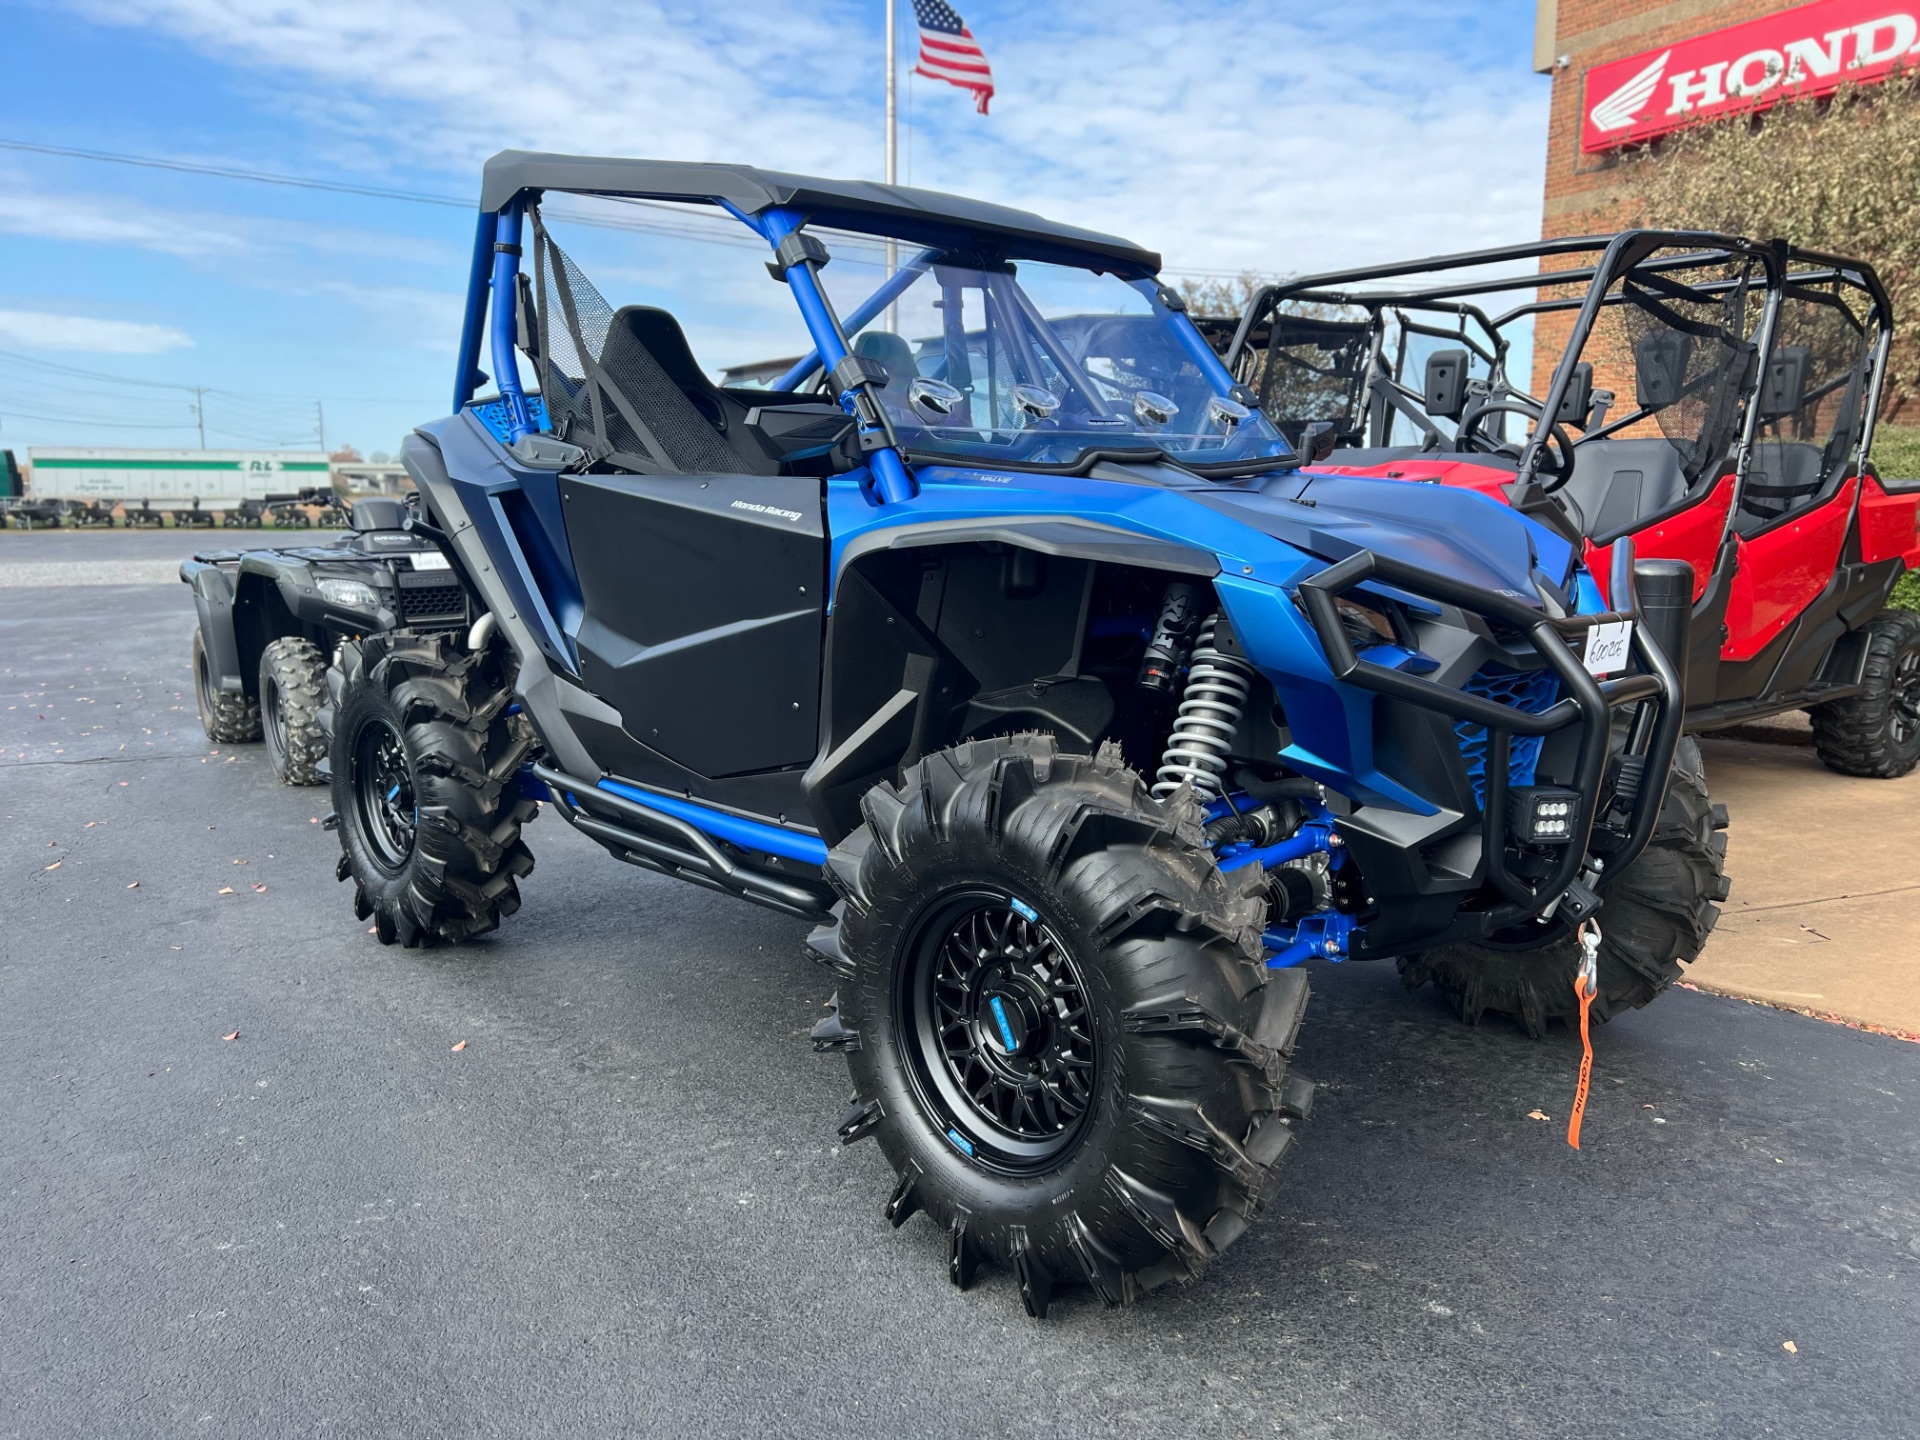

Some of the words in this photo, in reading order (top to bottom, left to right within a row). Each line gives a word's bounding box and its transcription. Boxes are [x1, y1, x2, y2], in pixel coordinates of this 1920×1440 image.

[1666, 14, 1920, 115] HOND
[980, 475, 1014, 484] VALVE
[730, 500, 766, 513] Honda
[764, 506, 803, 522] Racing
[1151, 593, 1189, 650] FOX
[1575, 1055, 1590, 1114] KOLPIN
